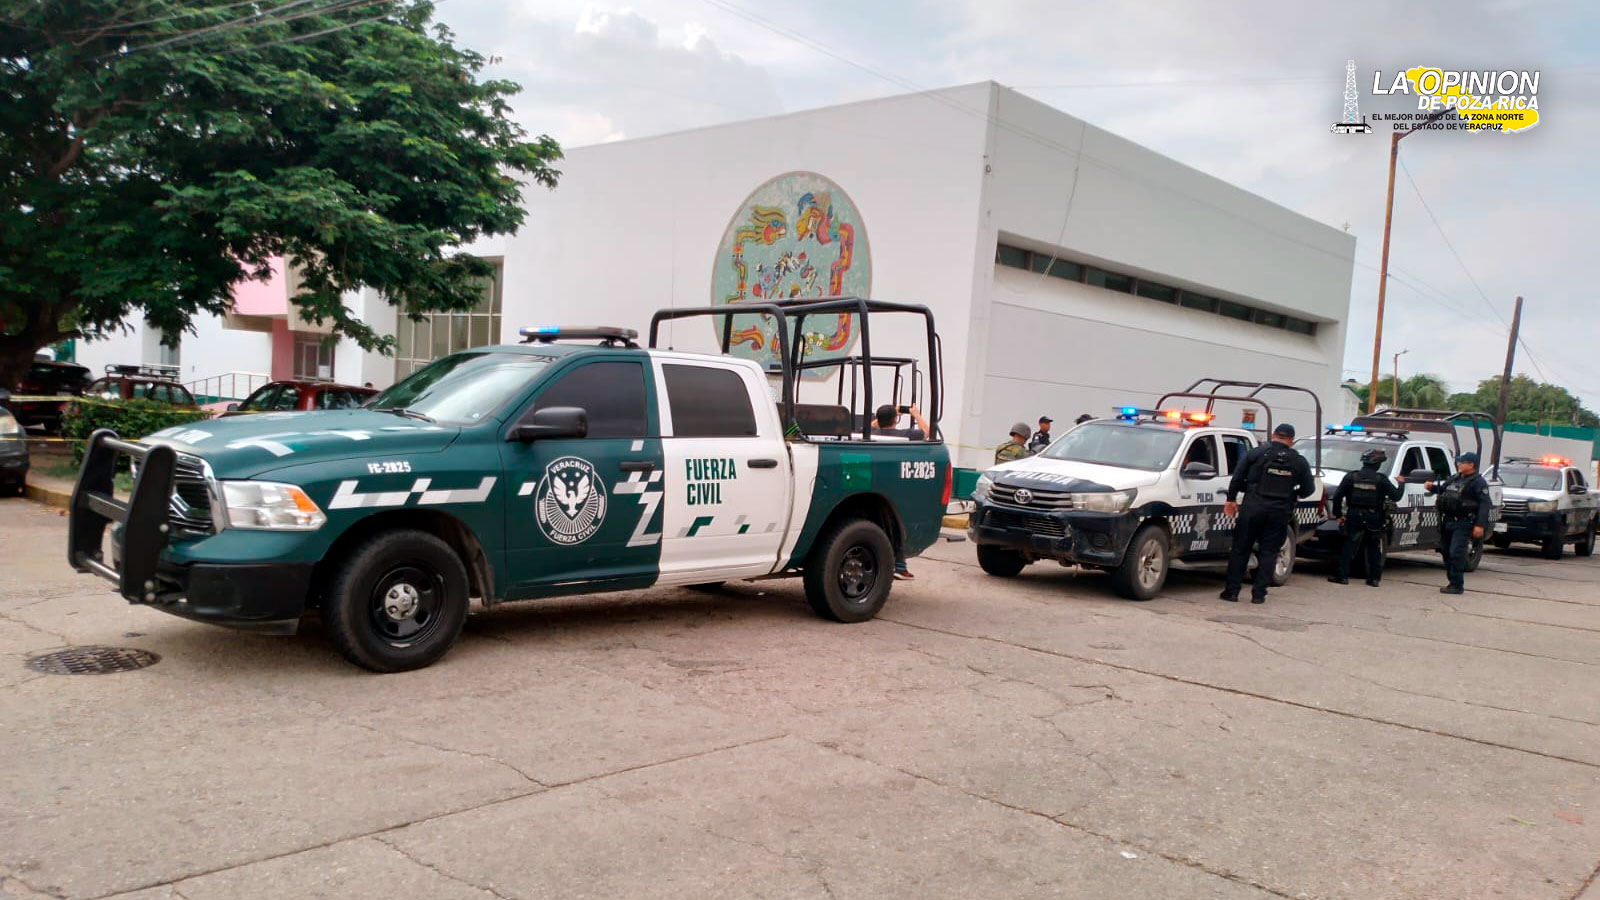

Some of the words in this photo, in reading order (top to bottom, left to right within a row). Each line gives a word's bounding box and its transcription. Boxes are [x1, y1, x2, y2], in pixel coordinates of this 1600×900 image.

[550, 460, 591, 474] VERACRUZ
[685, 459, 737, 480] FUERZA
[687, 483, 722, 505] CIVIL
[549, 528, 577, 542] FUERZA
[578, 523, 597, 540] CIVIL
